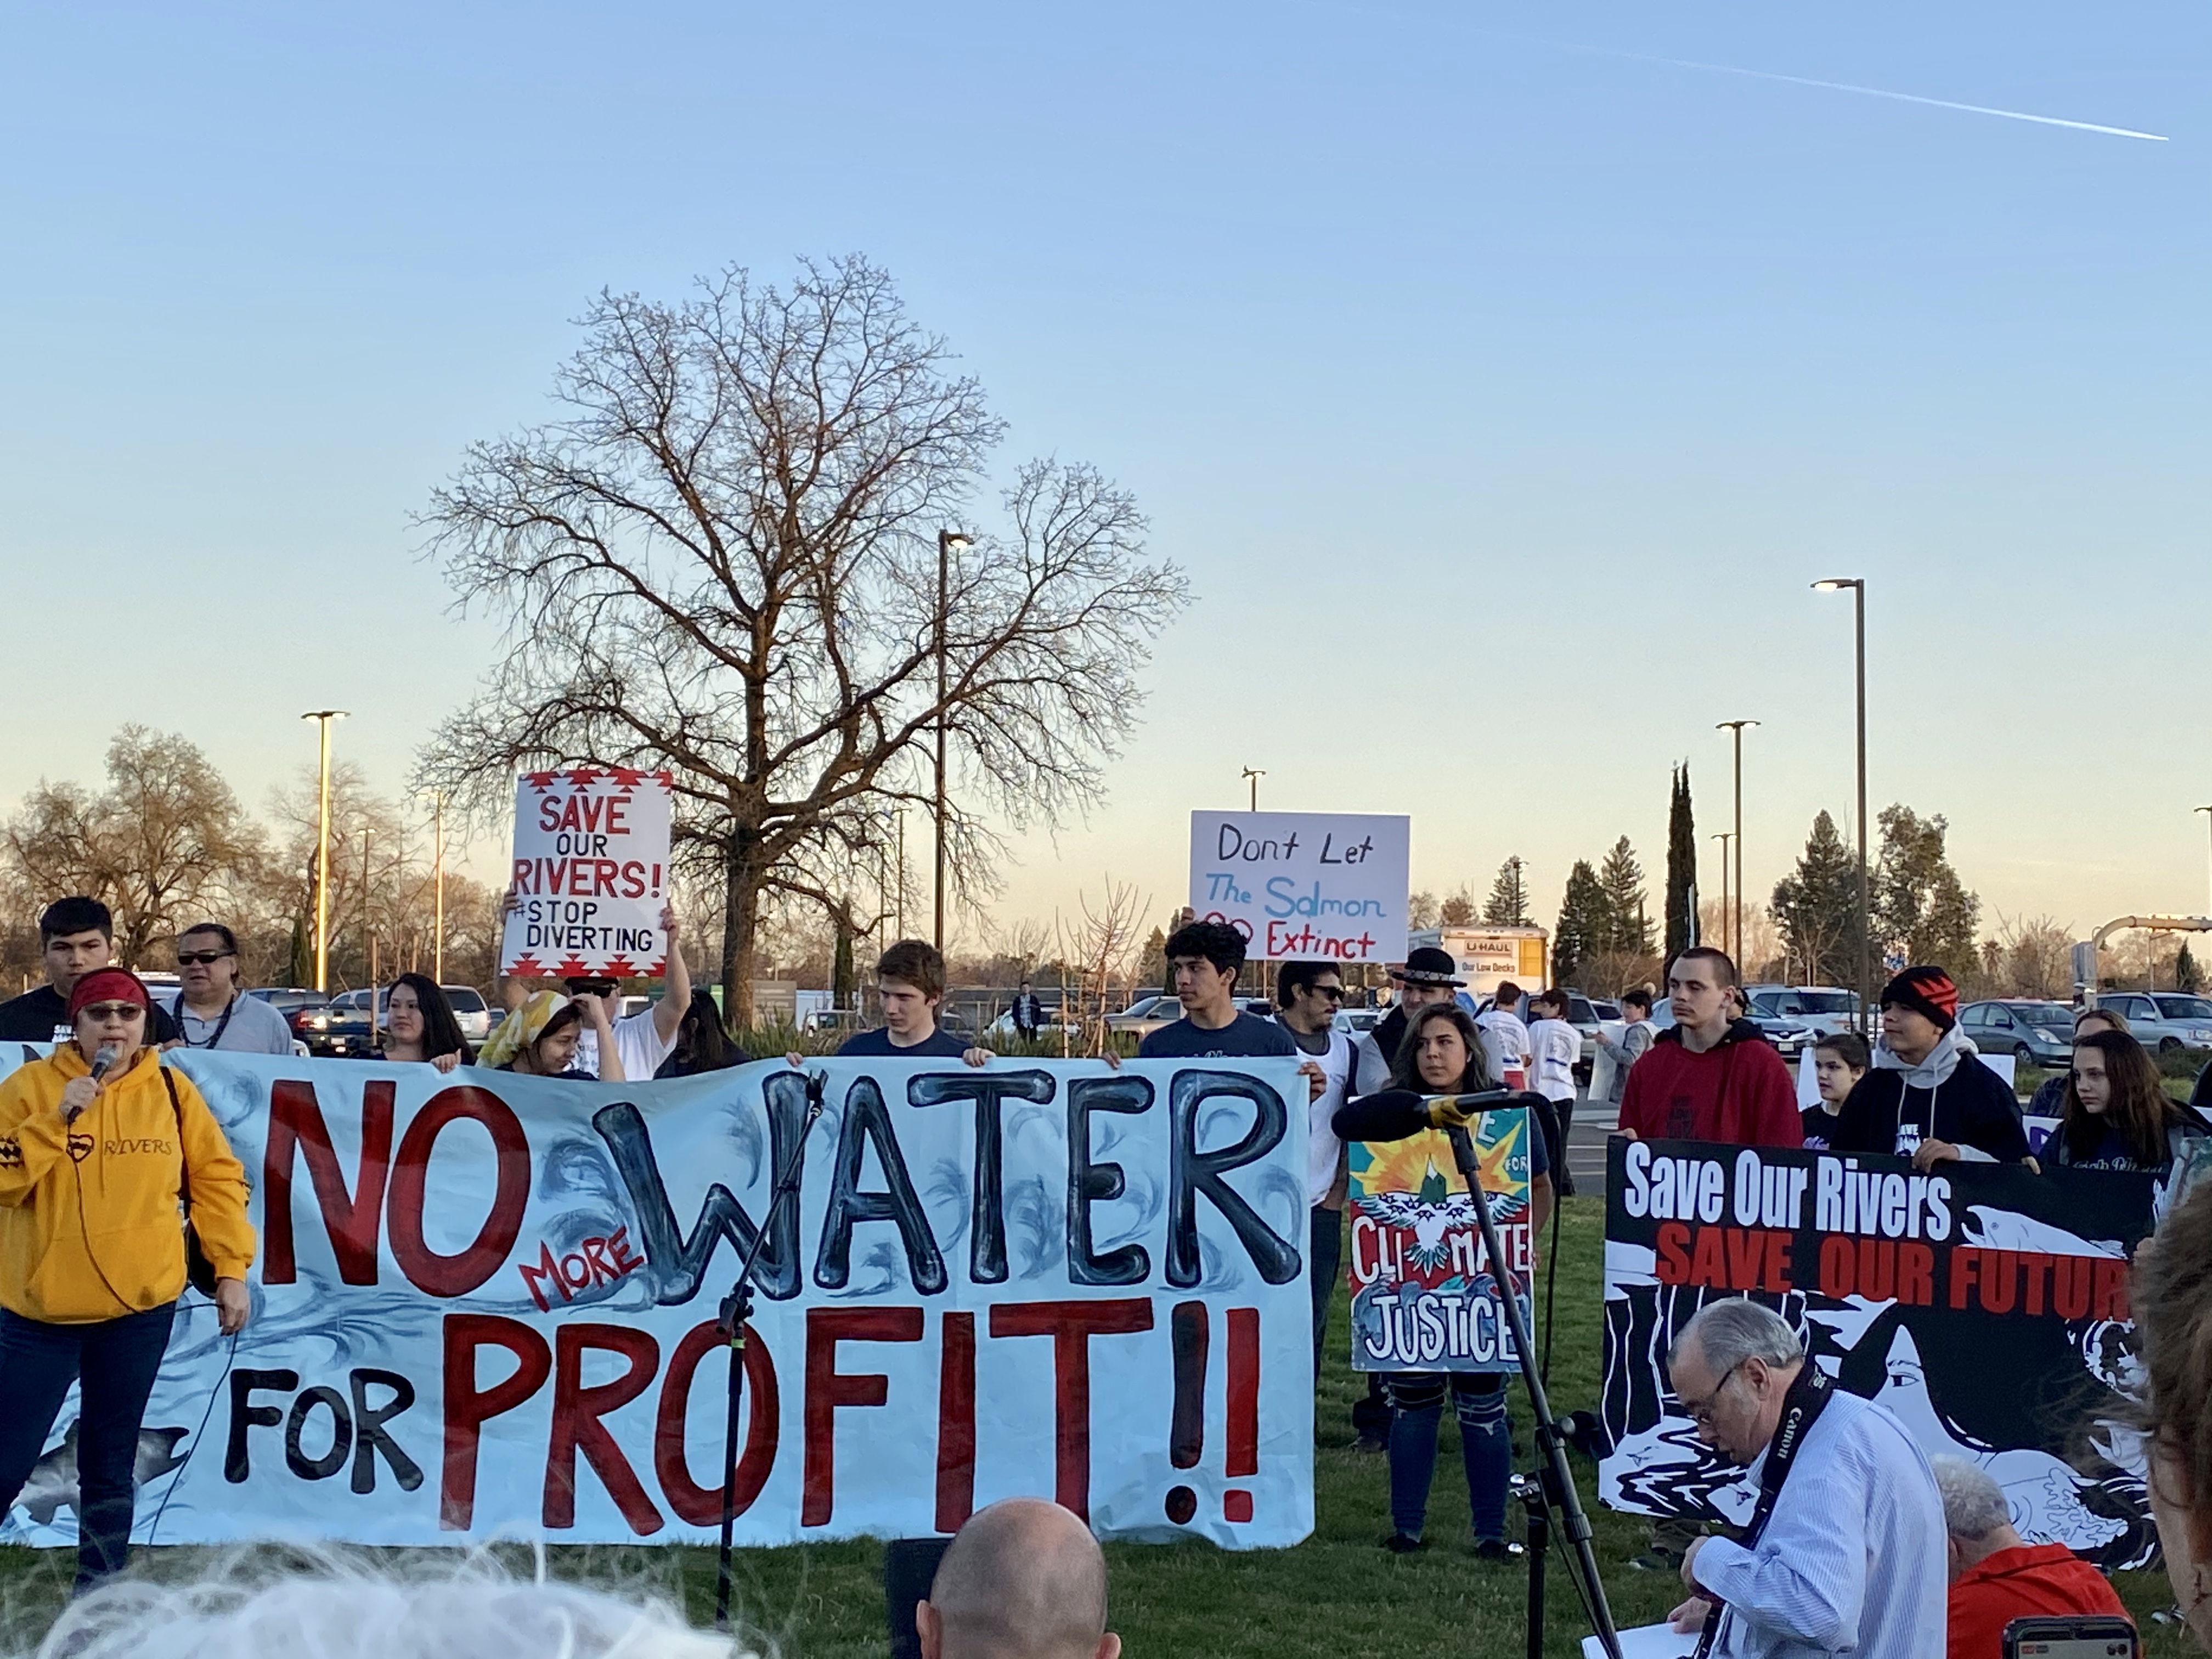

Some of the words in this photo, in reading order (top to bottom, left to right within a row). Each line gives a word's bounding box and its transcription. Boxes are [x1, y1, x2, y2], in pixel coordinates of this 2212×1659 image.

[539, 795, 631, 834] SAVE
[556, 833, 608, 857] OUR
[1319, 832, 1374, 864] Let
[514, 857, 661, 899] RIVERS!
[1206, 873, 1251, 904] The
[1265, 876, 1387, 918] Salmon
[527, 924, 652, 952] DIVERTING
[1267, 921, 1376, 959] Extinct
[104, 1139, 172, 1155] RIVERS
[262, 1080, 531, 1297] NO
[518, 1226, 645, 1313] MORE
[592, 1068, 1302, 1306] WATER
[1624, 1142, 1724, 1224] Save
[1734, 1149, 1808, 1230] Our
[1815, 1157, 1951, 1242] Rivers
[1656, 1221, 1792, 1294] SAVE
[1819, 1233, 1933, 1306] OUR
[1949, 1246, 2132, 1323] FUTUR
[1365, 1294, 1520, 1363] JUSTICE
[224, 1368, 424, 1495] FOR
[1777, 1407, 1802, 1459] Canon
